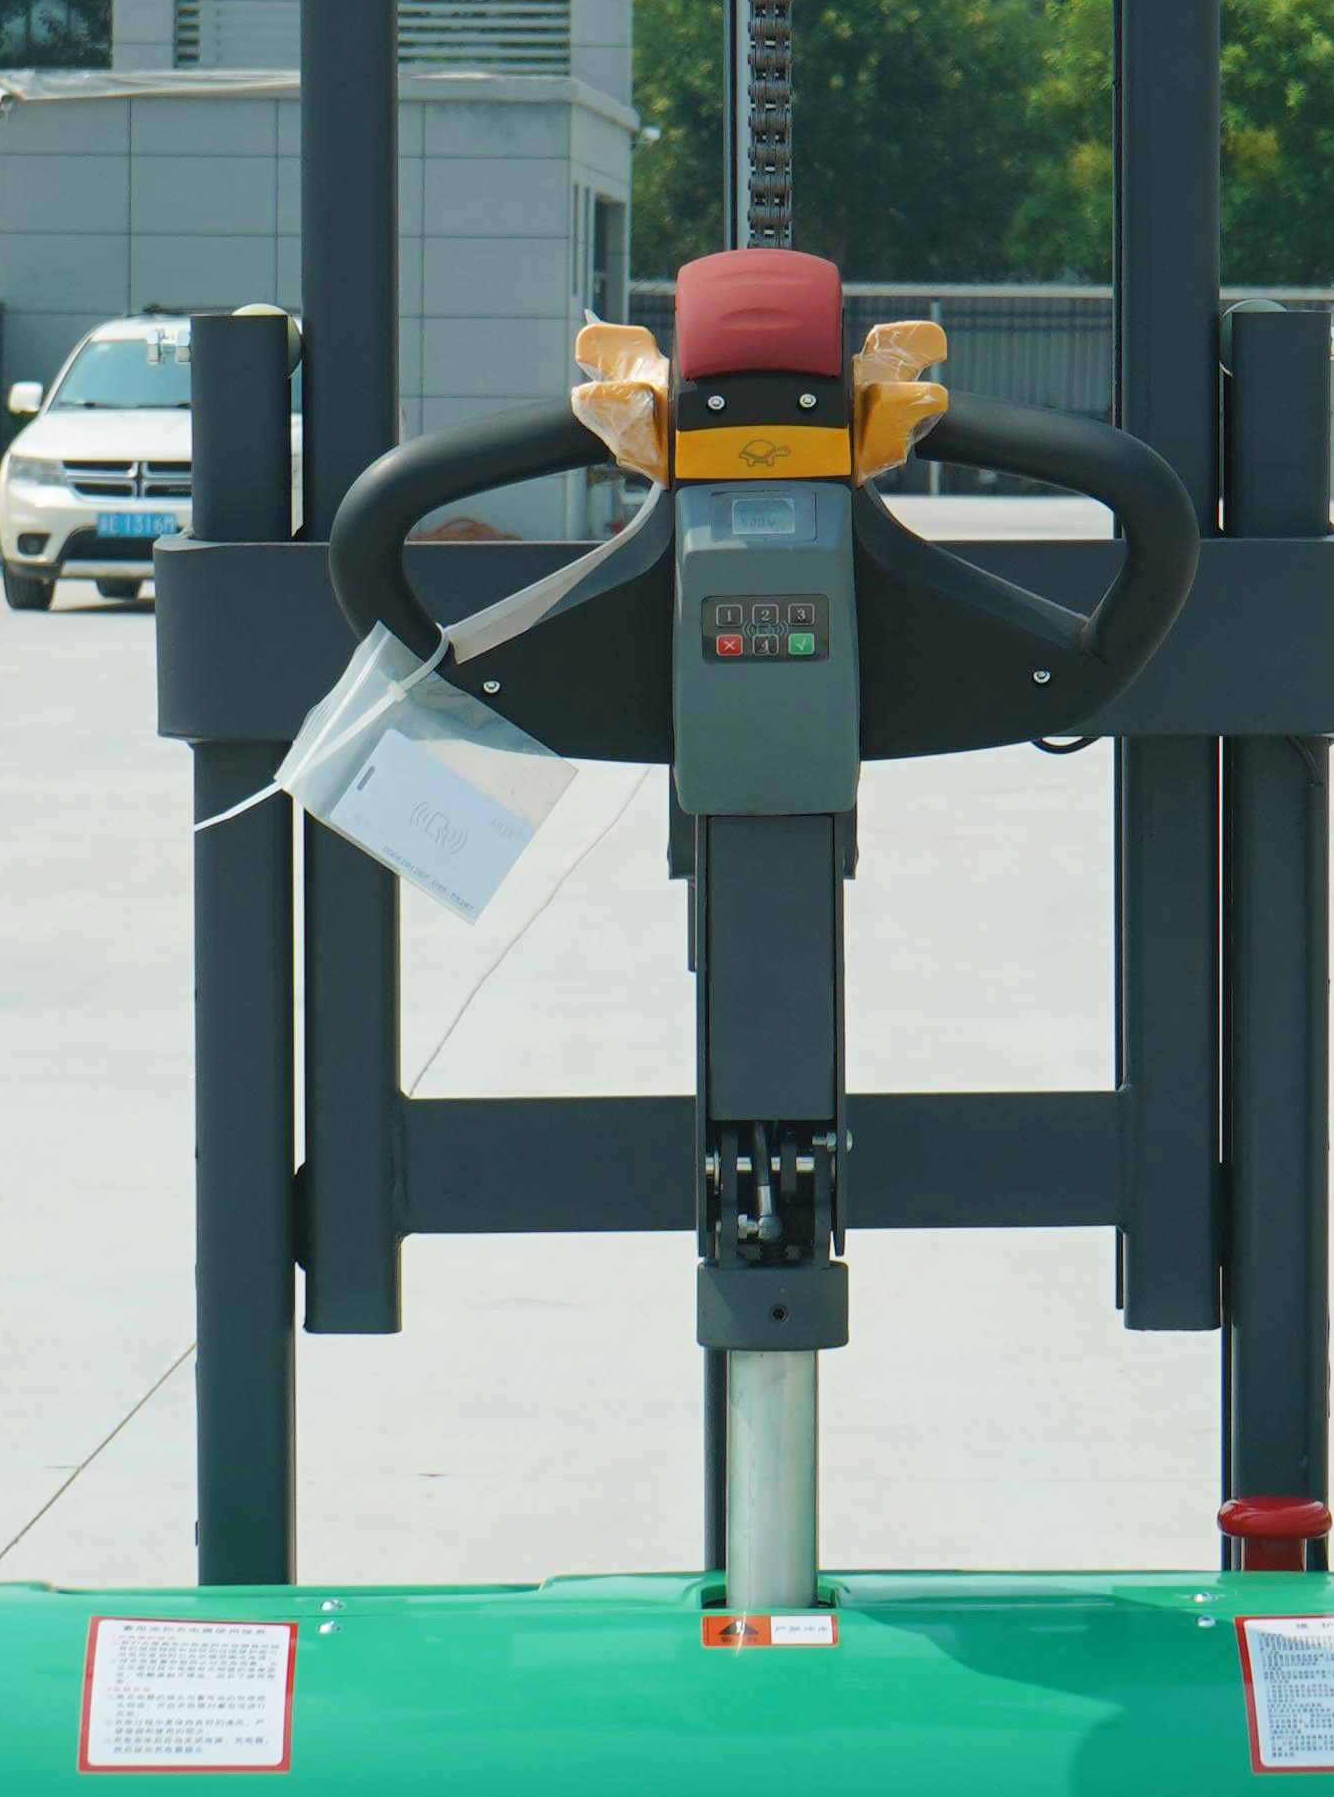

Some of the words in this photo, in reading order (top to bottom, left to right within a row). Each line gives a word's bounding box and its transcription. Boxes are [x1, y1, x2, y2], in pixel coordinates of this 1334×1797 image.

[726, 610, 732, 622] 1
[761, 609, 770, 621] 2
[797, 608, 806, 620] 3
